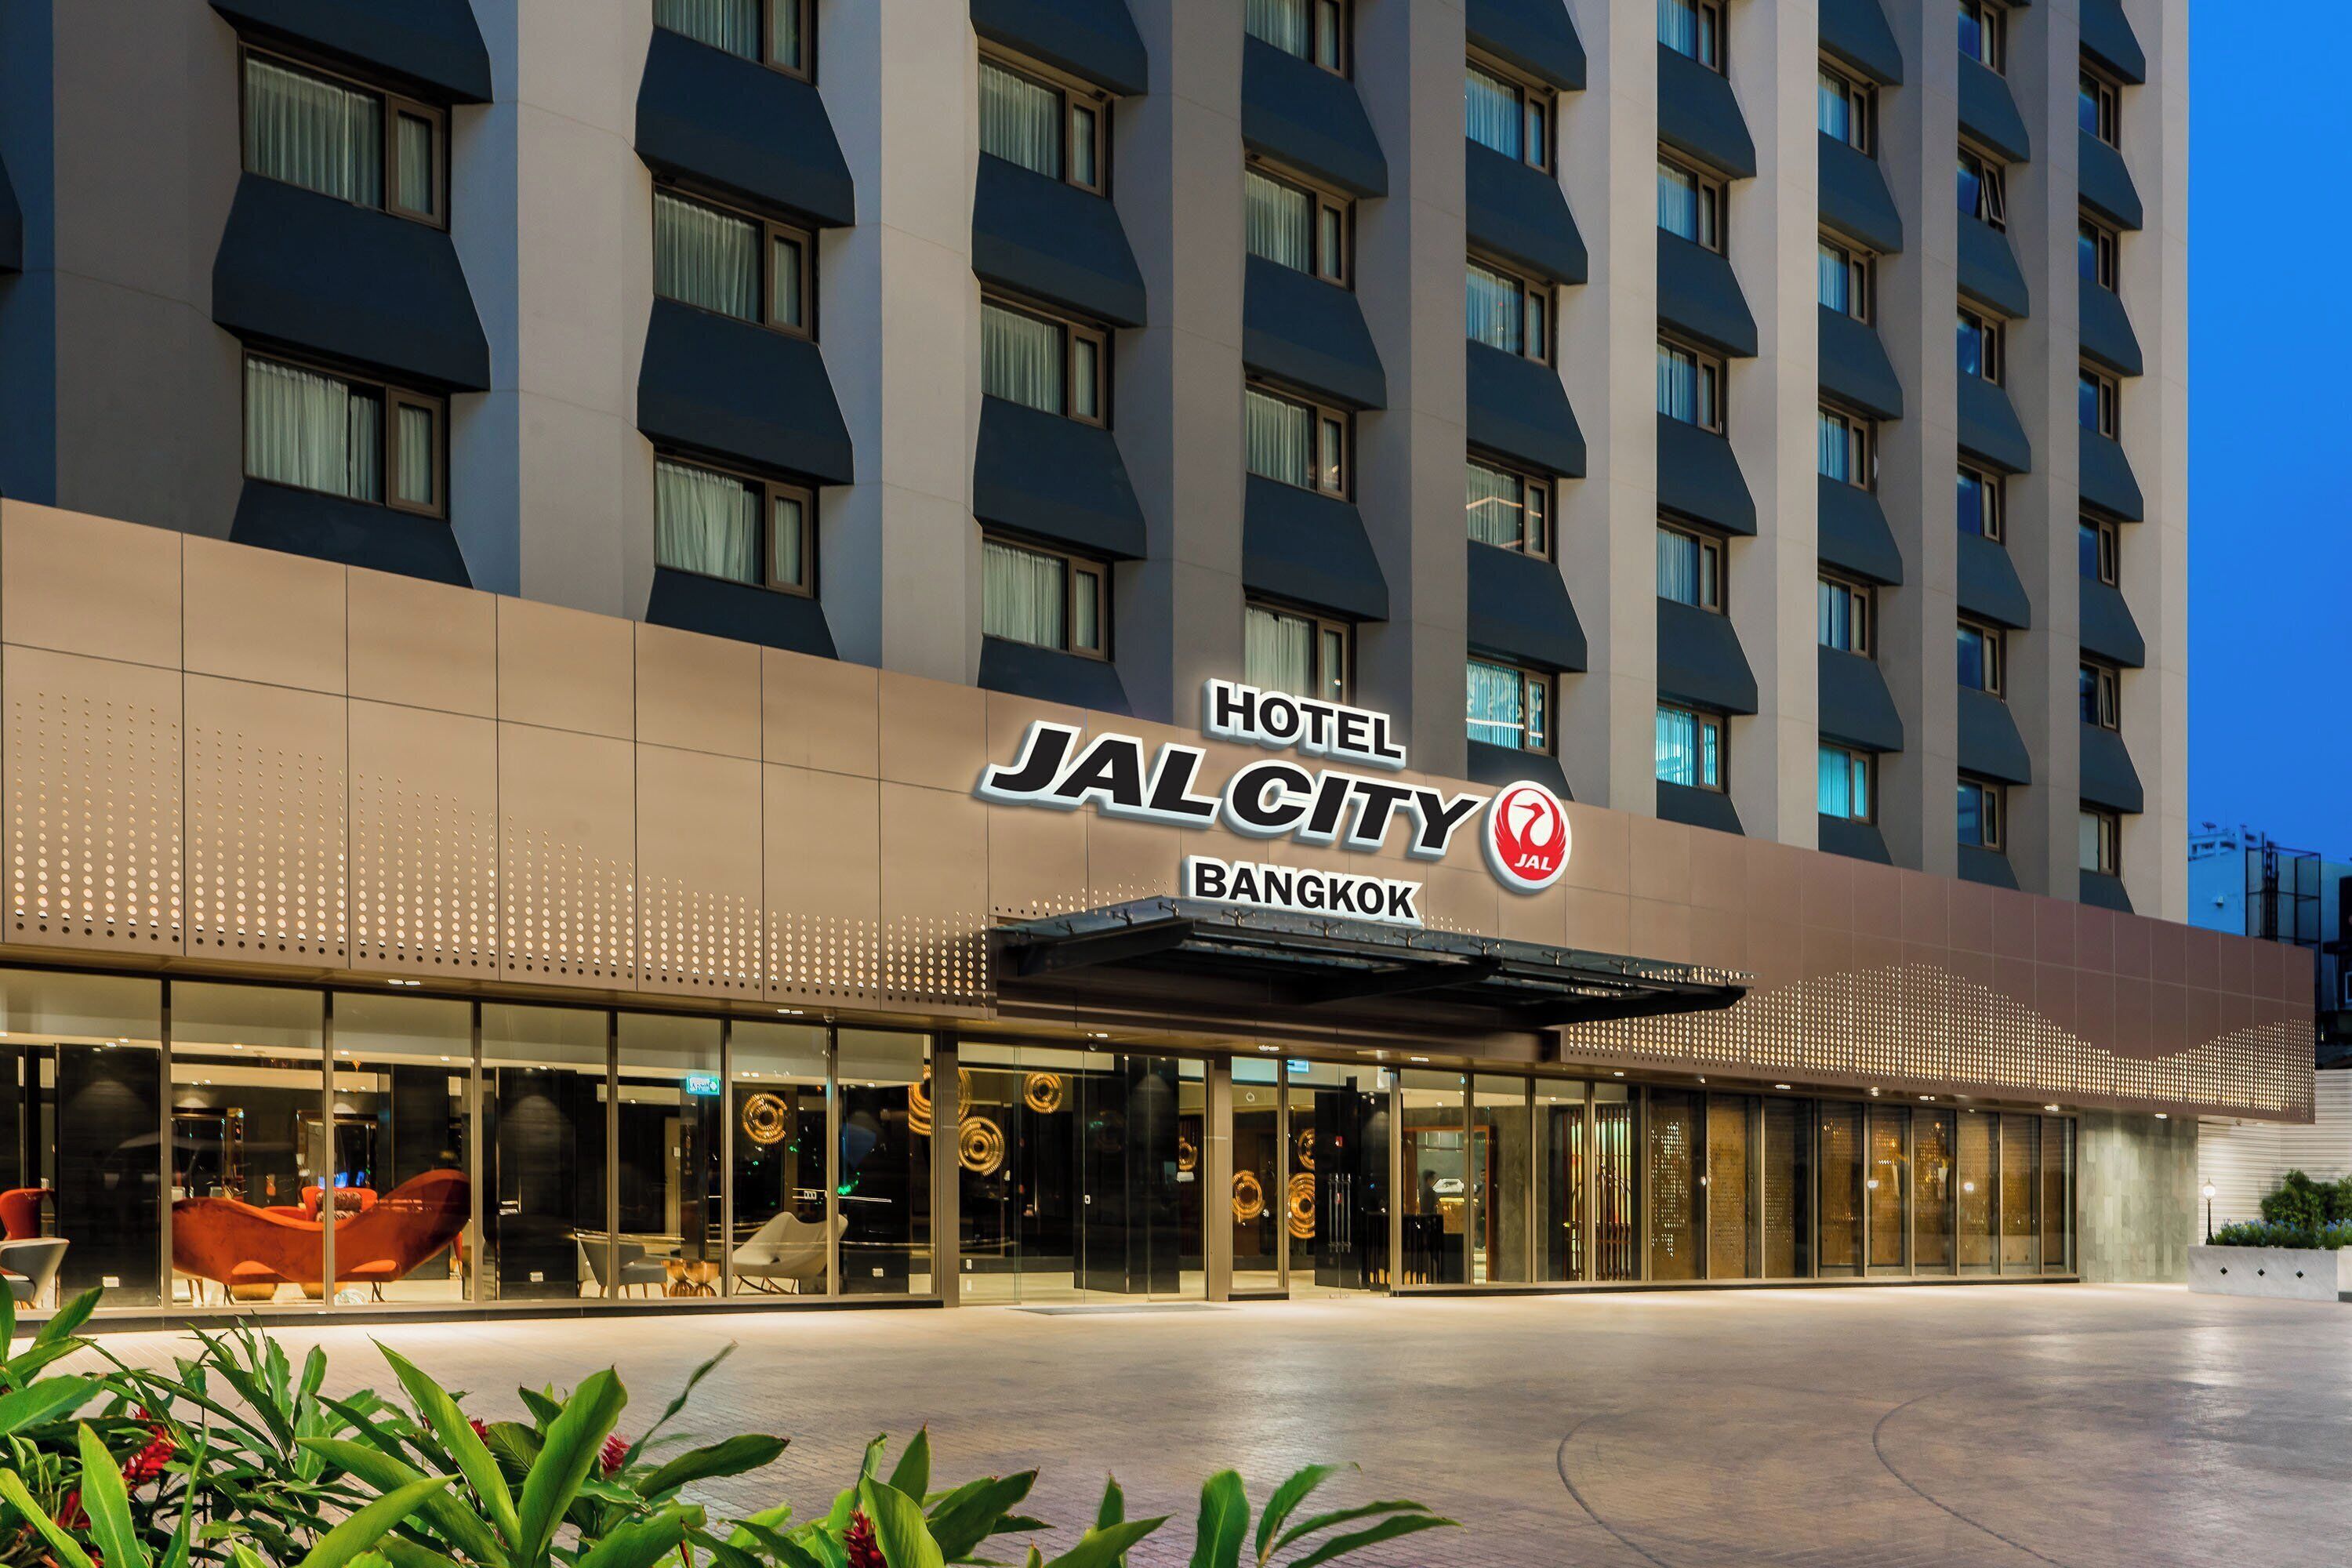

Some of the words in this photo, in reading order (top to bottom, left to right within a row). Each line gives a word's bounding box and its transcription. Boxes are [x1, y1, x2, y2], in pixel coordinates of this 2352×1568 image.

[1216, 685, 1402, 760] HOTEL
[989, 727, 1215, 817] JAL
[1232, 765, 1479, 850] CITY
[1195, 862, 1415, 919] BANGKOK
[1514, 853, 1552, 871] JAL
